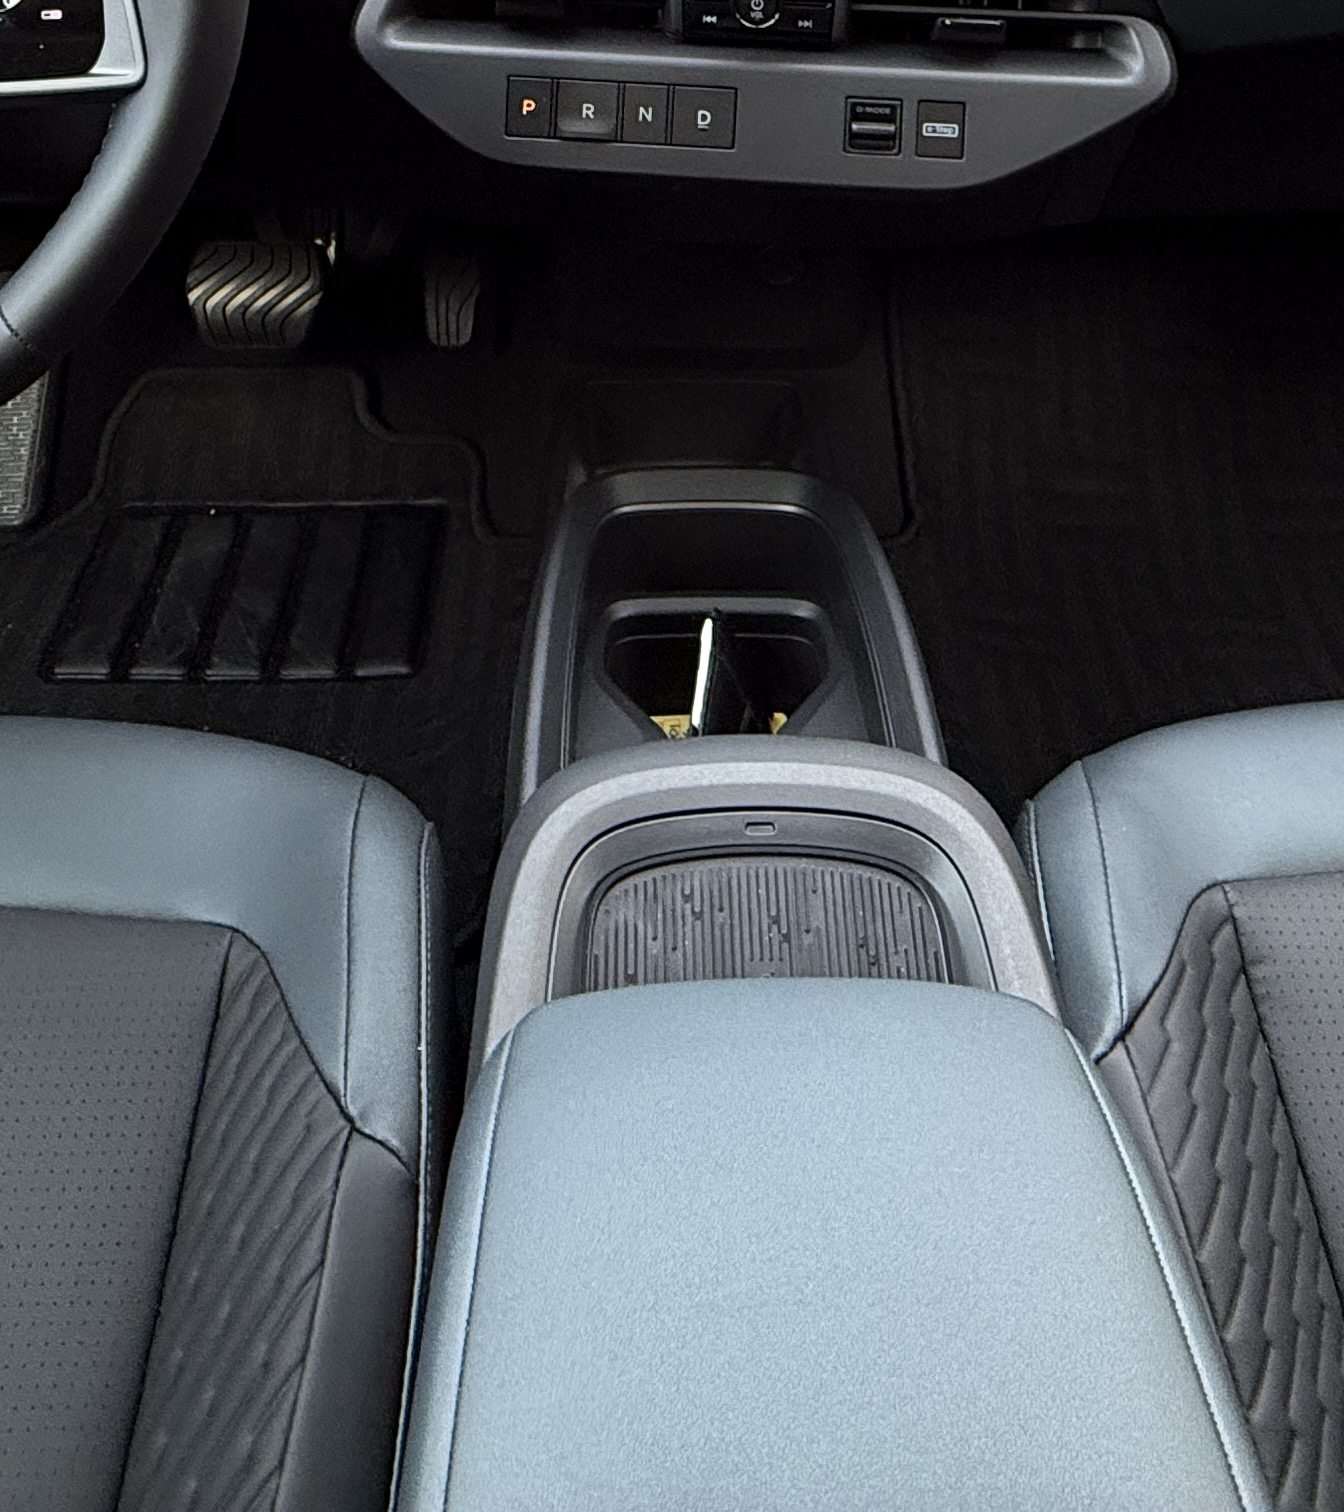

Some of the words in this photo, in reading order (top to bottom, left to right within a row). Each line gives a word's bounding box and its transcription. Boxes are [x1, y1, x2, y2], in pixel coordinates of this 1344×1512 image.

[750, 11, 764, 19] VOL
[522, 99, 536, 116] P
[582, 103, 595, 119] R
[639, 106, 653, 122] N
[697, 109, 712, 125] D
